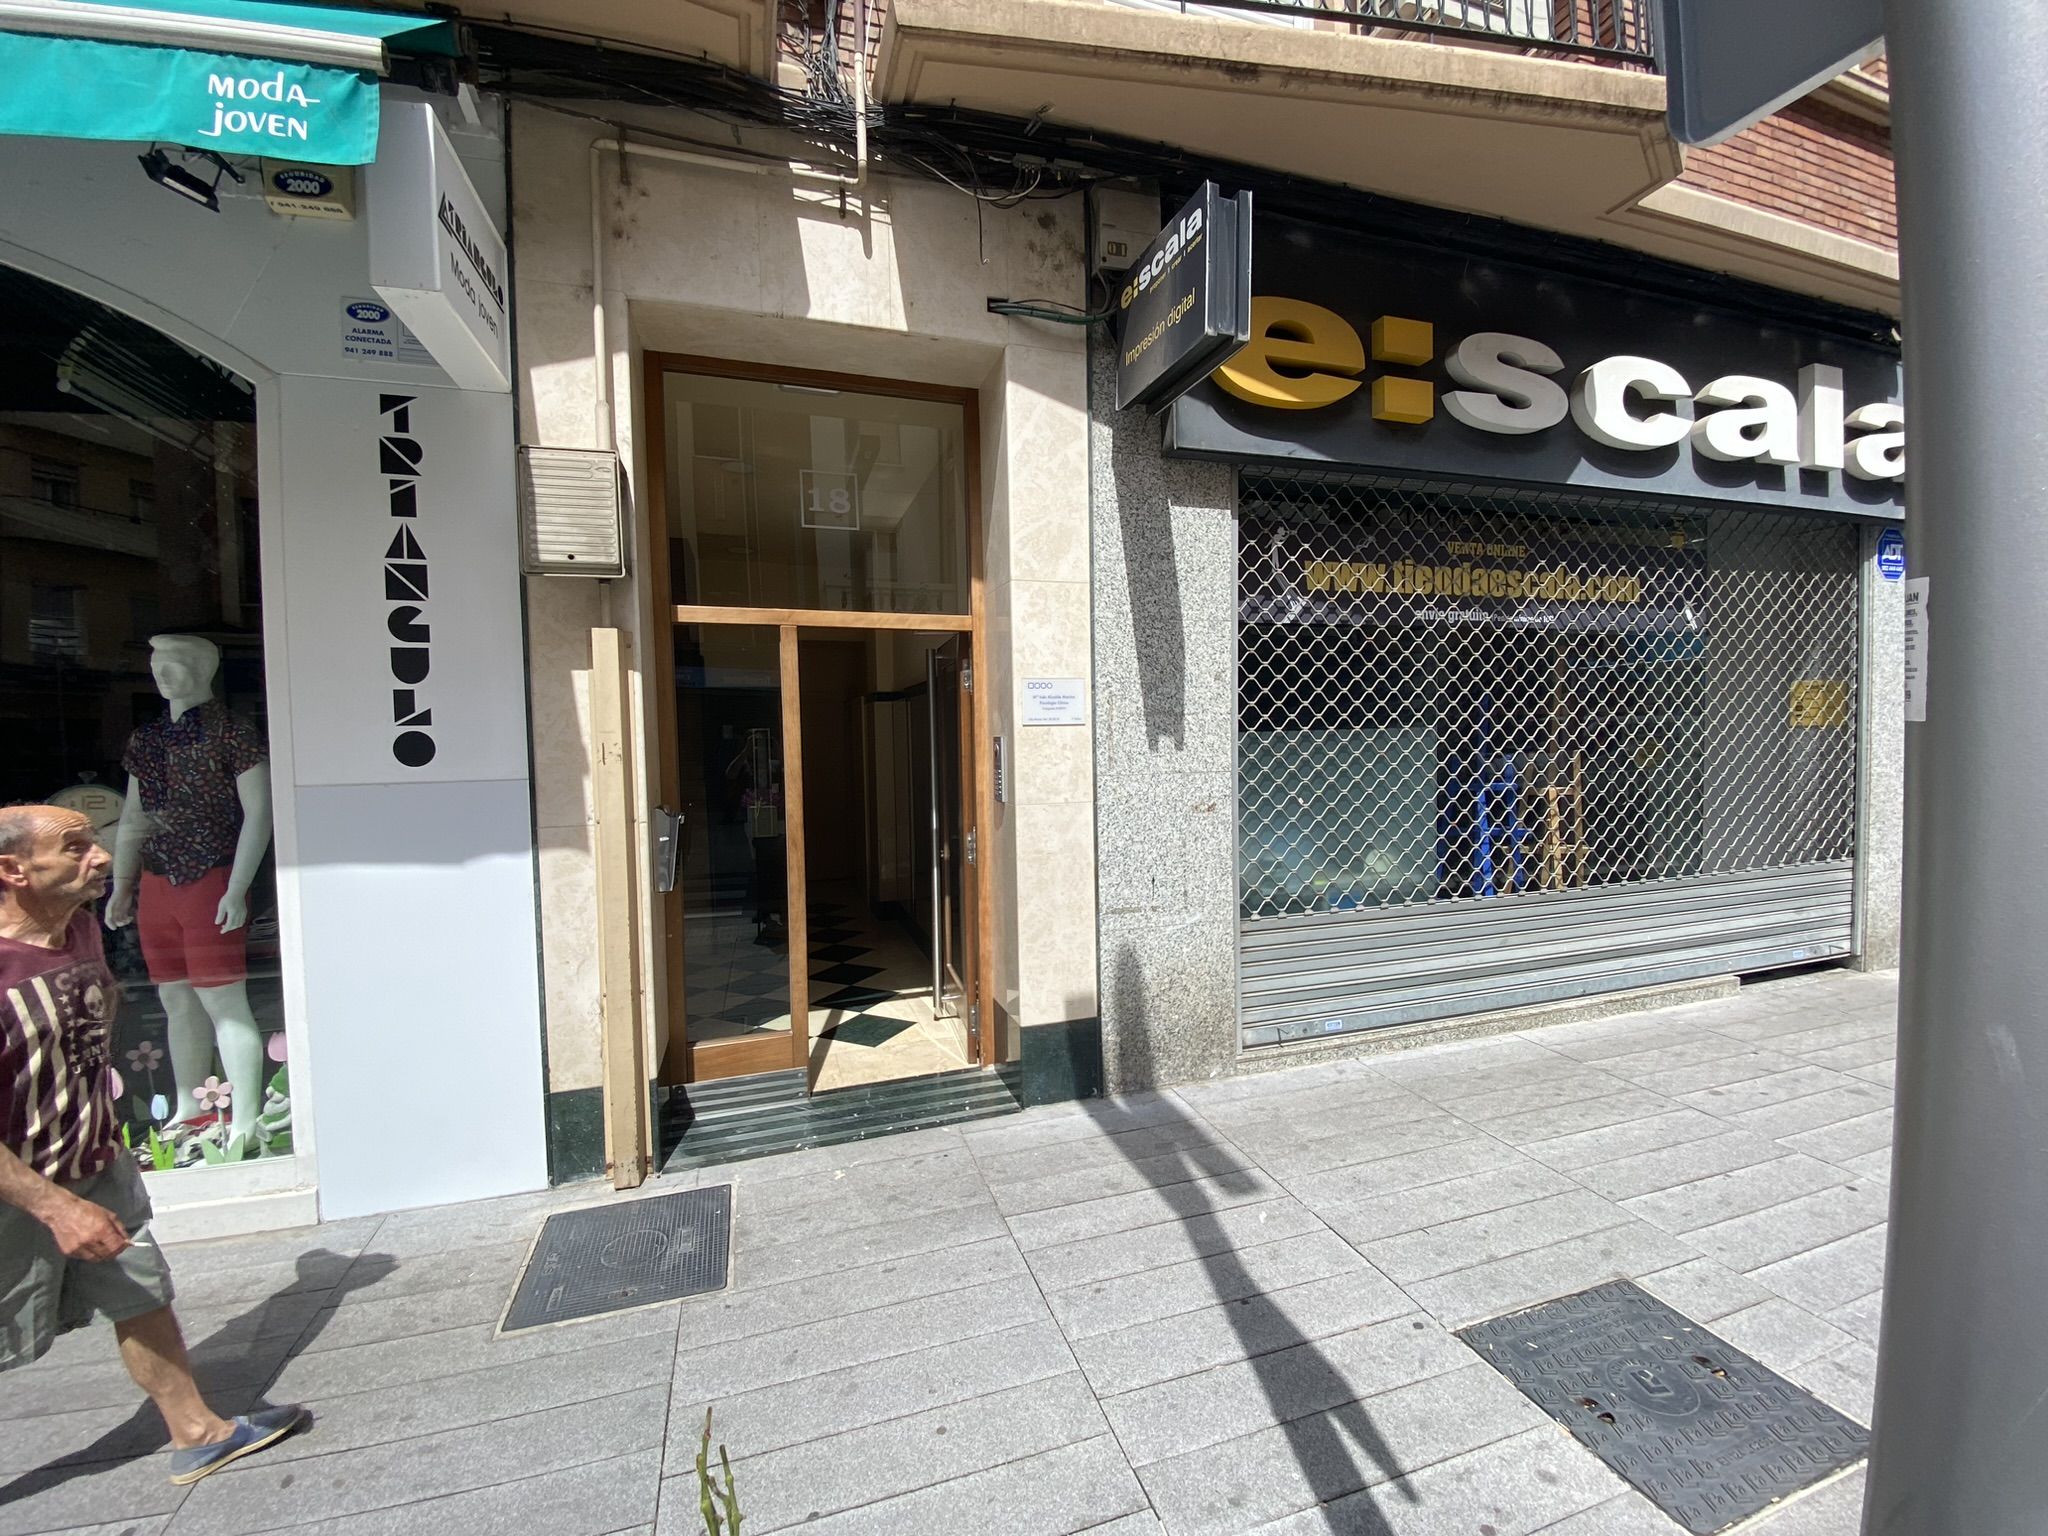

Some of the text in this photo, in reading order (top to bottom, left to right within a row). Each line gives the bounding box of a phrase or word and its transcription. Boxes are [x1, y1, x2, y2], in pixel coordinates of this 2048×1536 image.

[286, 178, 321, 195] 2000
[450, 251, 499, 339] Moda joven
[356, 309, 381, 321] 2000
[352, 327, 385, 337] ALARMA
[1125, 286, 1196, 367] Impresión digital
[345, 335, 393, 346] CONECTADA
[344, 346, 359, 354] 941
[361, 348, 377, 356] 249
[807, 487, 852, 514] 18
[1447, 540, 1485, 557] VENTA
[1882, 543, 1905, 561] ADT
[379, 392, 437, 769] TRIANGULO
[81, 794, 107, 810] 12
